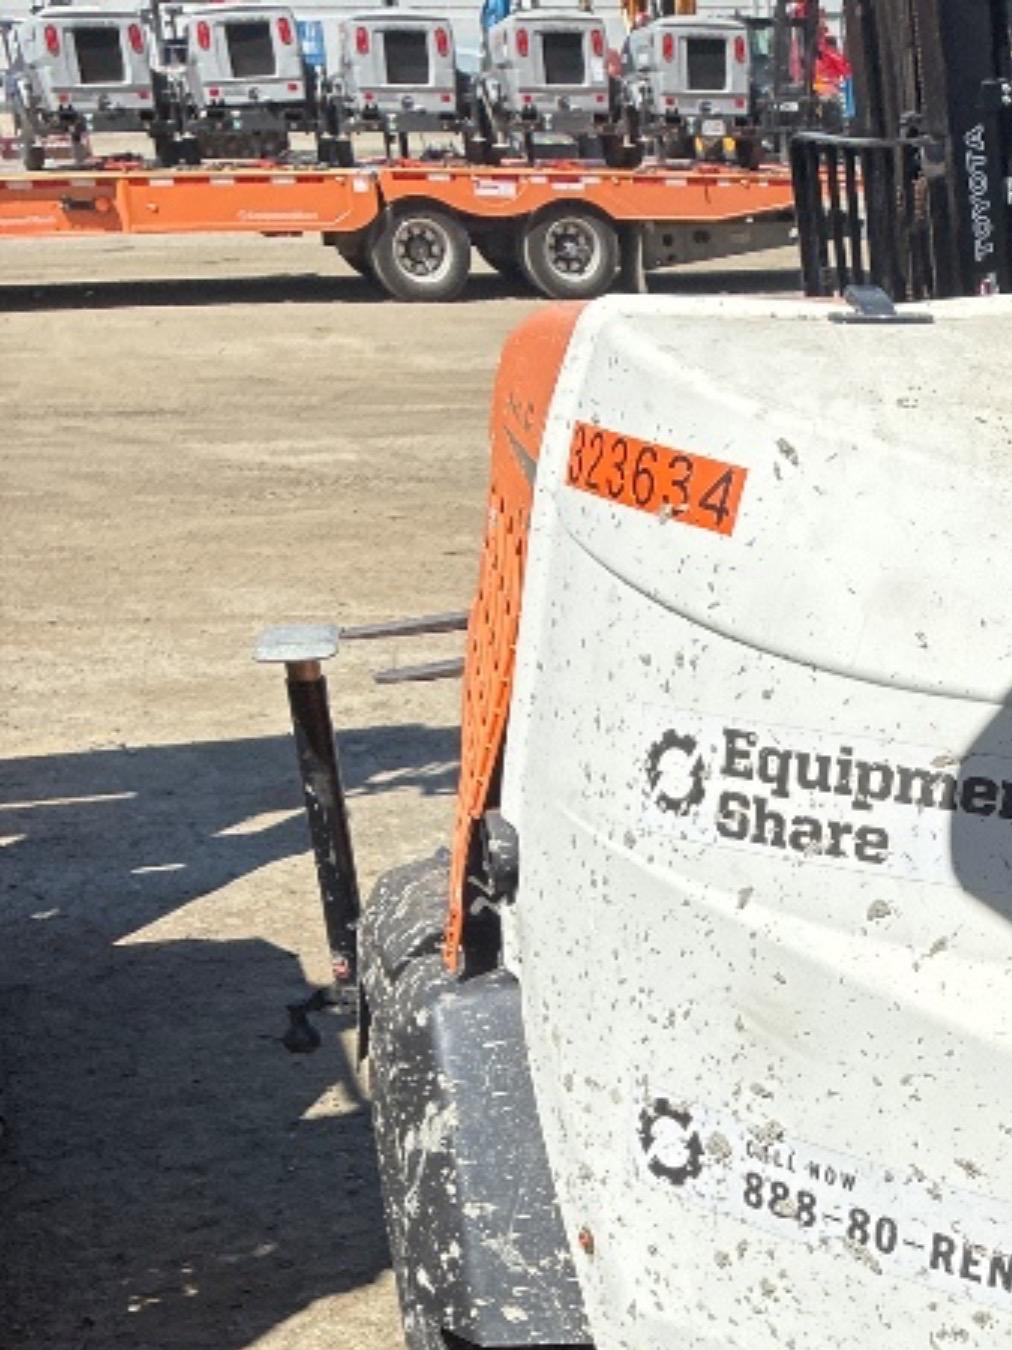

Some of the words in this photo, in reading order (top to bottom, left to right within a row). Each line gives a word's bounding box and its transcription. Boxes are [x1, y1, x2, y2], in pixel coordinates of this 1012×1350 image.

[963, 123, 994, 263] TOYOTA
[567, 424, 735, 527] 323634
[715, 790, 890, 864] Share
[807, 1160, 857, 1192] NOW
